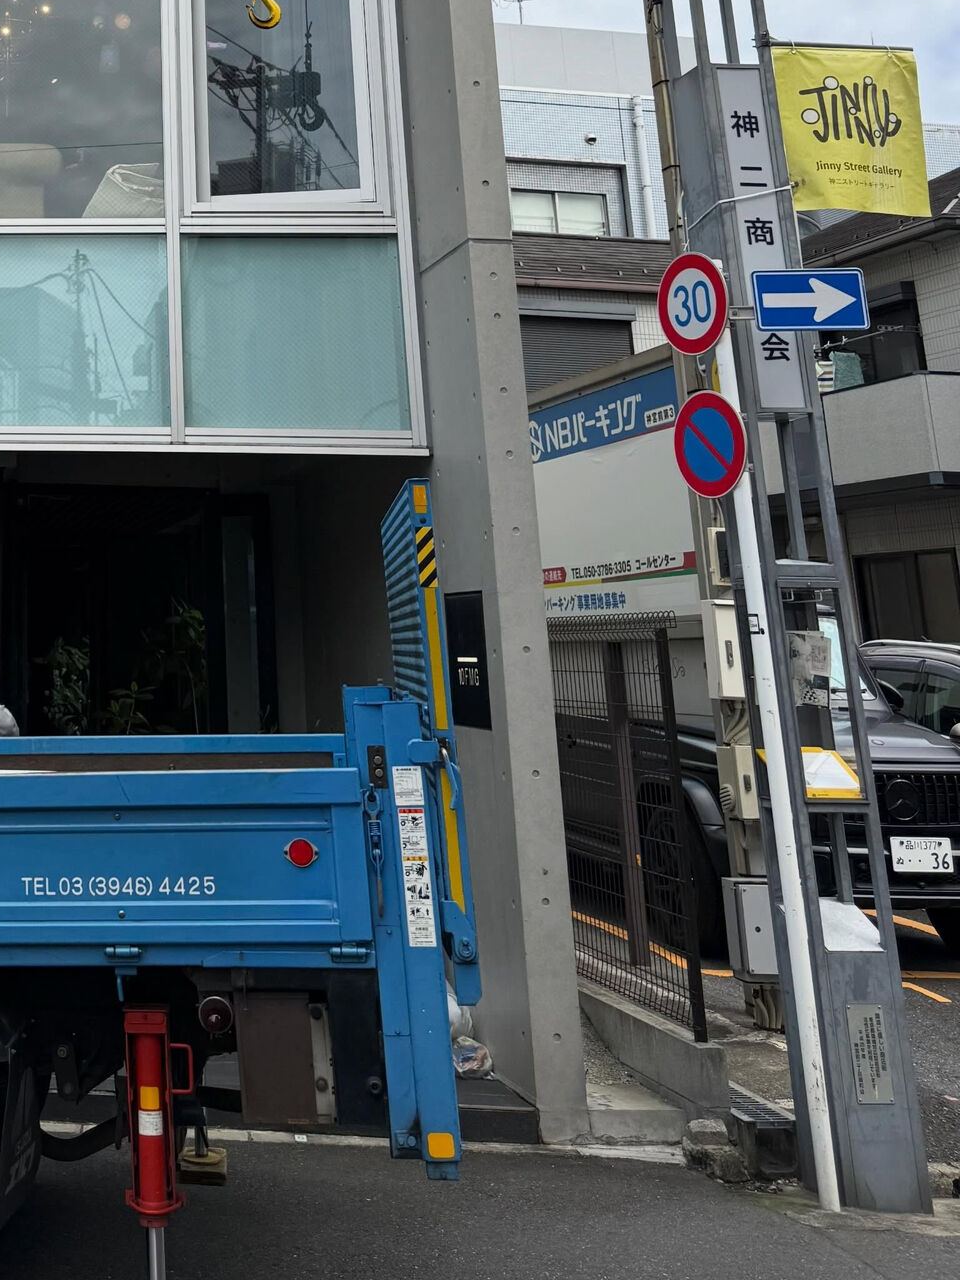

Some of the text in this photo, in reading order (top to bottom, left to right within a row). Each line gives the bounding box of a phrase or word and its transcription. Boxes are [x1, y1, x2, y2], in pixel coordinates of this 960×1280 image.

[799, 75, 902, 148] JINNY
[816, 160, 902, 178] Jinny Street Gallery
[730, 110, 791, 362] 神二商会
[673, 280, 712, 328] 30
[544, 393, 642, 453] NBパーキング
[635, 553, 676, 571] コールセンター
[544, 591, 627, 612] パーキング事業用地募集中
[158, 875, 216, 895] 4425
